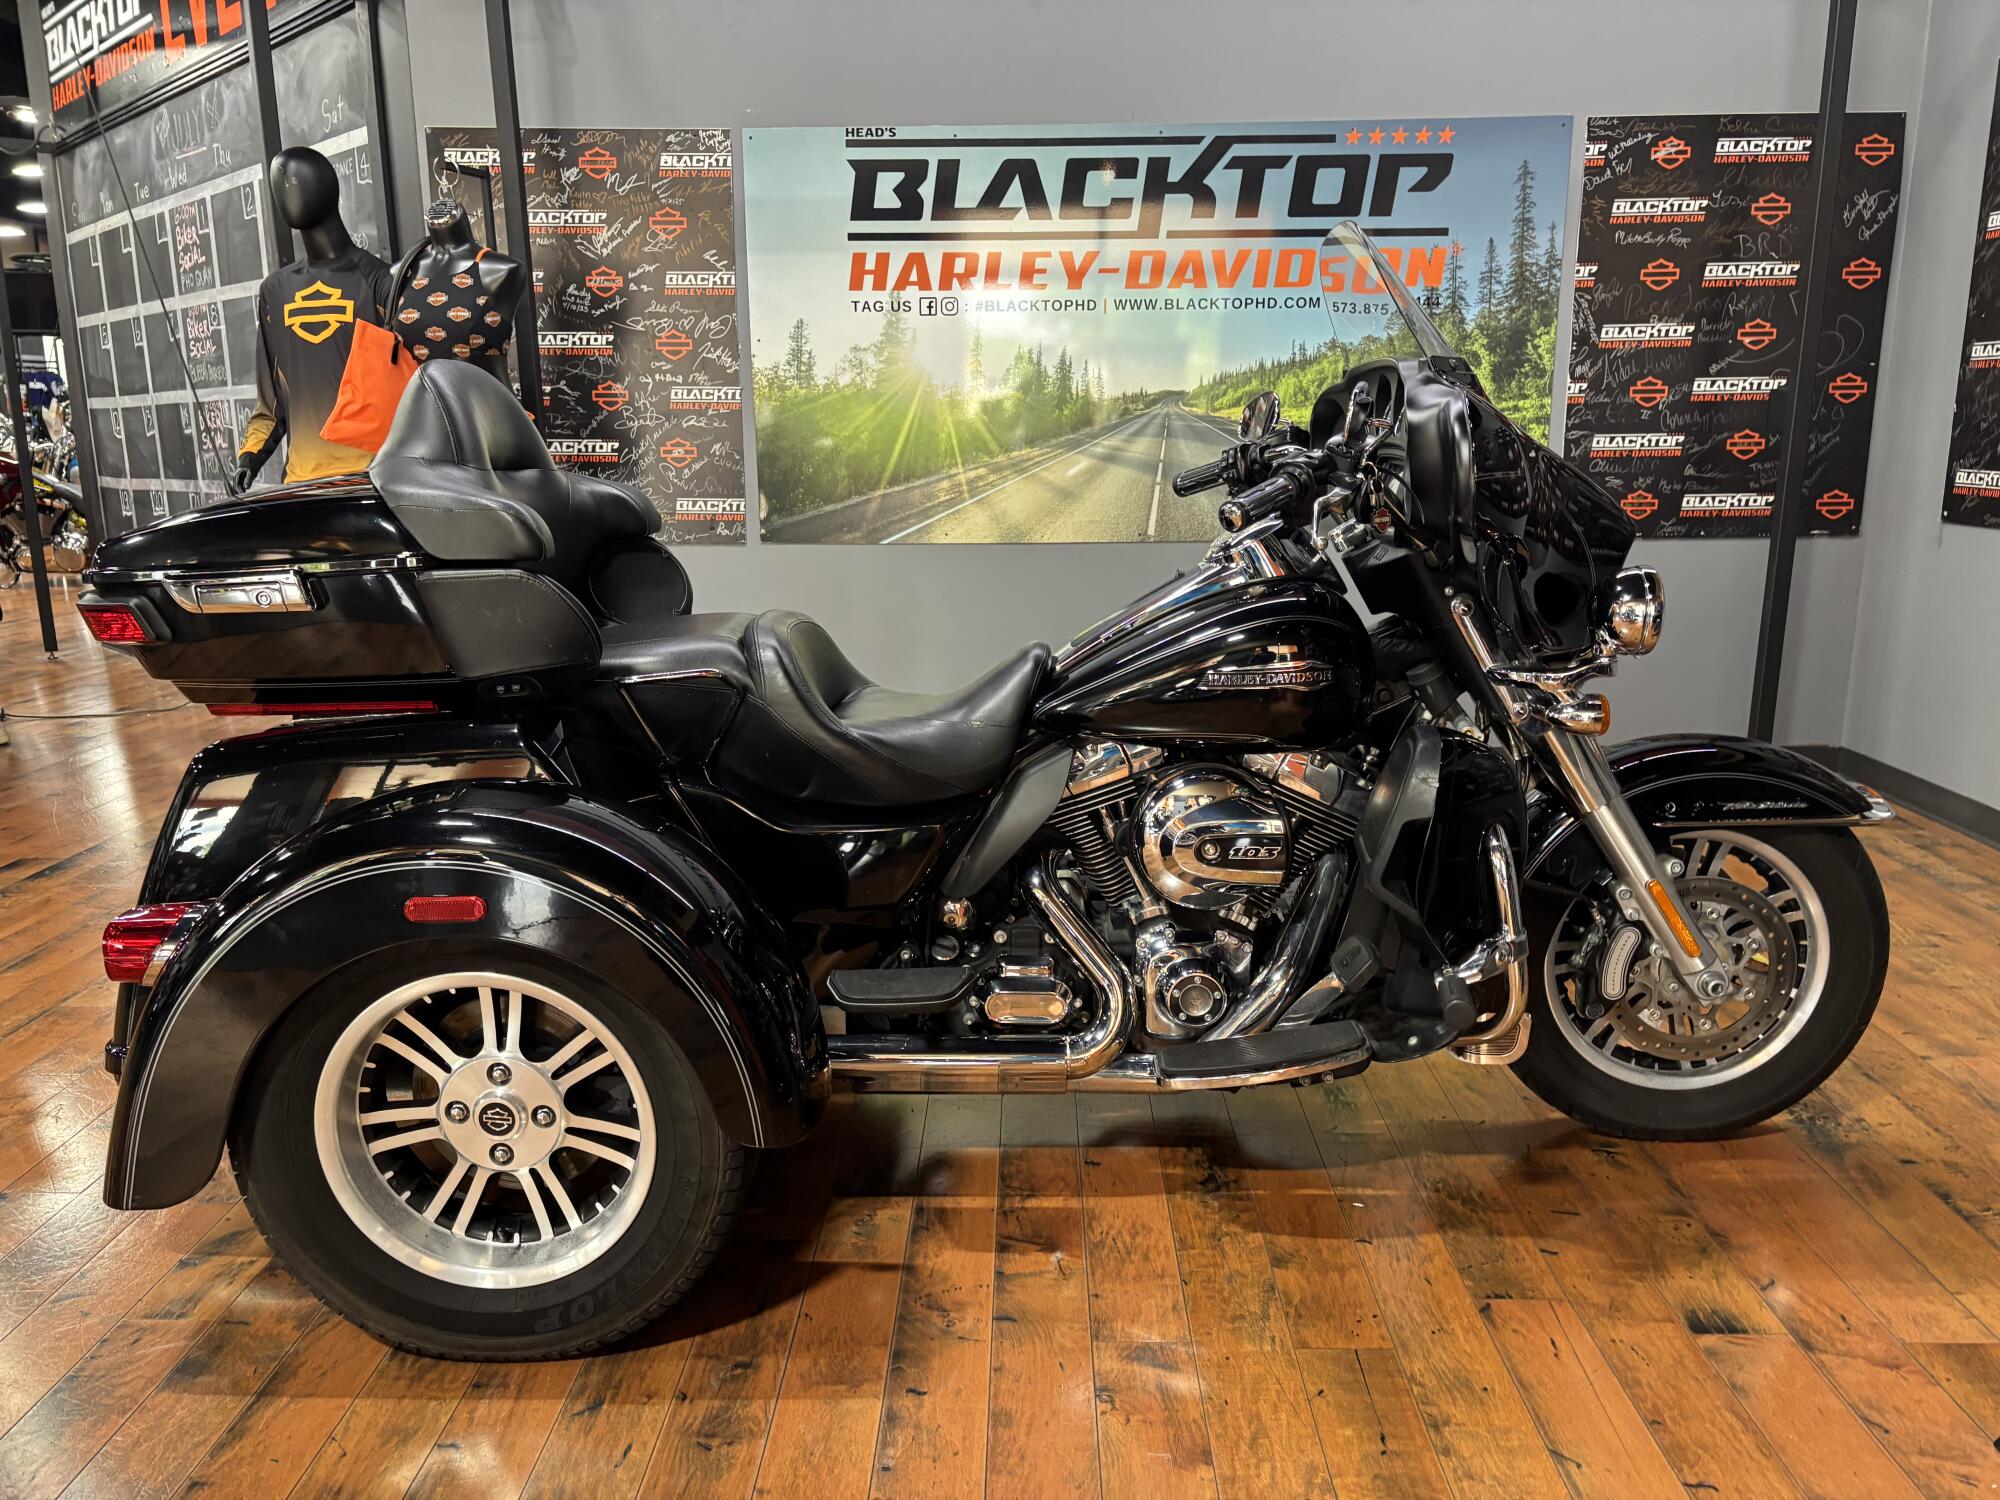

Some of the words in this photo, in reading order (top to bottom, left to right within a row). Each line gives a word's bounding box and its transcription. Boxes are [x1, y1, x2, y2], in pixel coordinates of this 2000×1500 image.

[52, 28, 156, 112] HARLEY-DAVIDSON
[321, 94, 343, 132] Sat
[845, 127, 897, 138] HEAD'S
[1715, 137, 1812, 154] BLACKTOP
[212, 143, 231, 168] Thu
[1714, 154, 1810, 164] HARLEY-DAVIDSON
[167, 162, 187, 189] Wed
[134, 181, 150, 203] Tue
[847, 136, 1454, 238] BLACKTOP
[1611, 198, 1709, 215] BLACKTOP
[528, 210, 607, 225] LACKTOP
[1609, 215, 1706, 224] HARLEY-DAVIDSON
[529, 227, 608, 235] RLEY-DAVIDSON
[849, 247, 1448, 293] HARLEY-DAVIDSON
[1704, 262, 1800, 279] BLACKTOP
[1701, 279, 1797, 288] HARLEY-DAVIDSON
[851, 300, 884, 313] TAG
[890, 300, 912, 312] US
[975, 299, 1097, 312] #BLACKTOPHD
[1113, 296, 1321, 312] WWW.BLACKTOPHD.COM
[538, 332, 614, 348] LACKTOP
[1600, 324, 1695, 340] BLACKTOP
[1598, 340, 1692, 349] HARLEY-DAVIDSON
[1692, 376, 1788, 393] BLACKTOP
[550, 440, 619, 455] ACKTOP
[1592, 433, 1686, 449] BLACKTOP
[1589, 449, 1682, 458] HARLEY-DAVIDSON
[1682, 493, 1775, 509] BLACKTOP
[1680, 509, 1772, 518] HARLEY-DAVIDSON
[1208, 670, 1332, 686] HARLEY-DAVIDSON
[1228, 846, 1281, 860] 103
